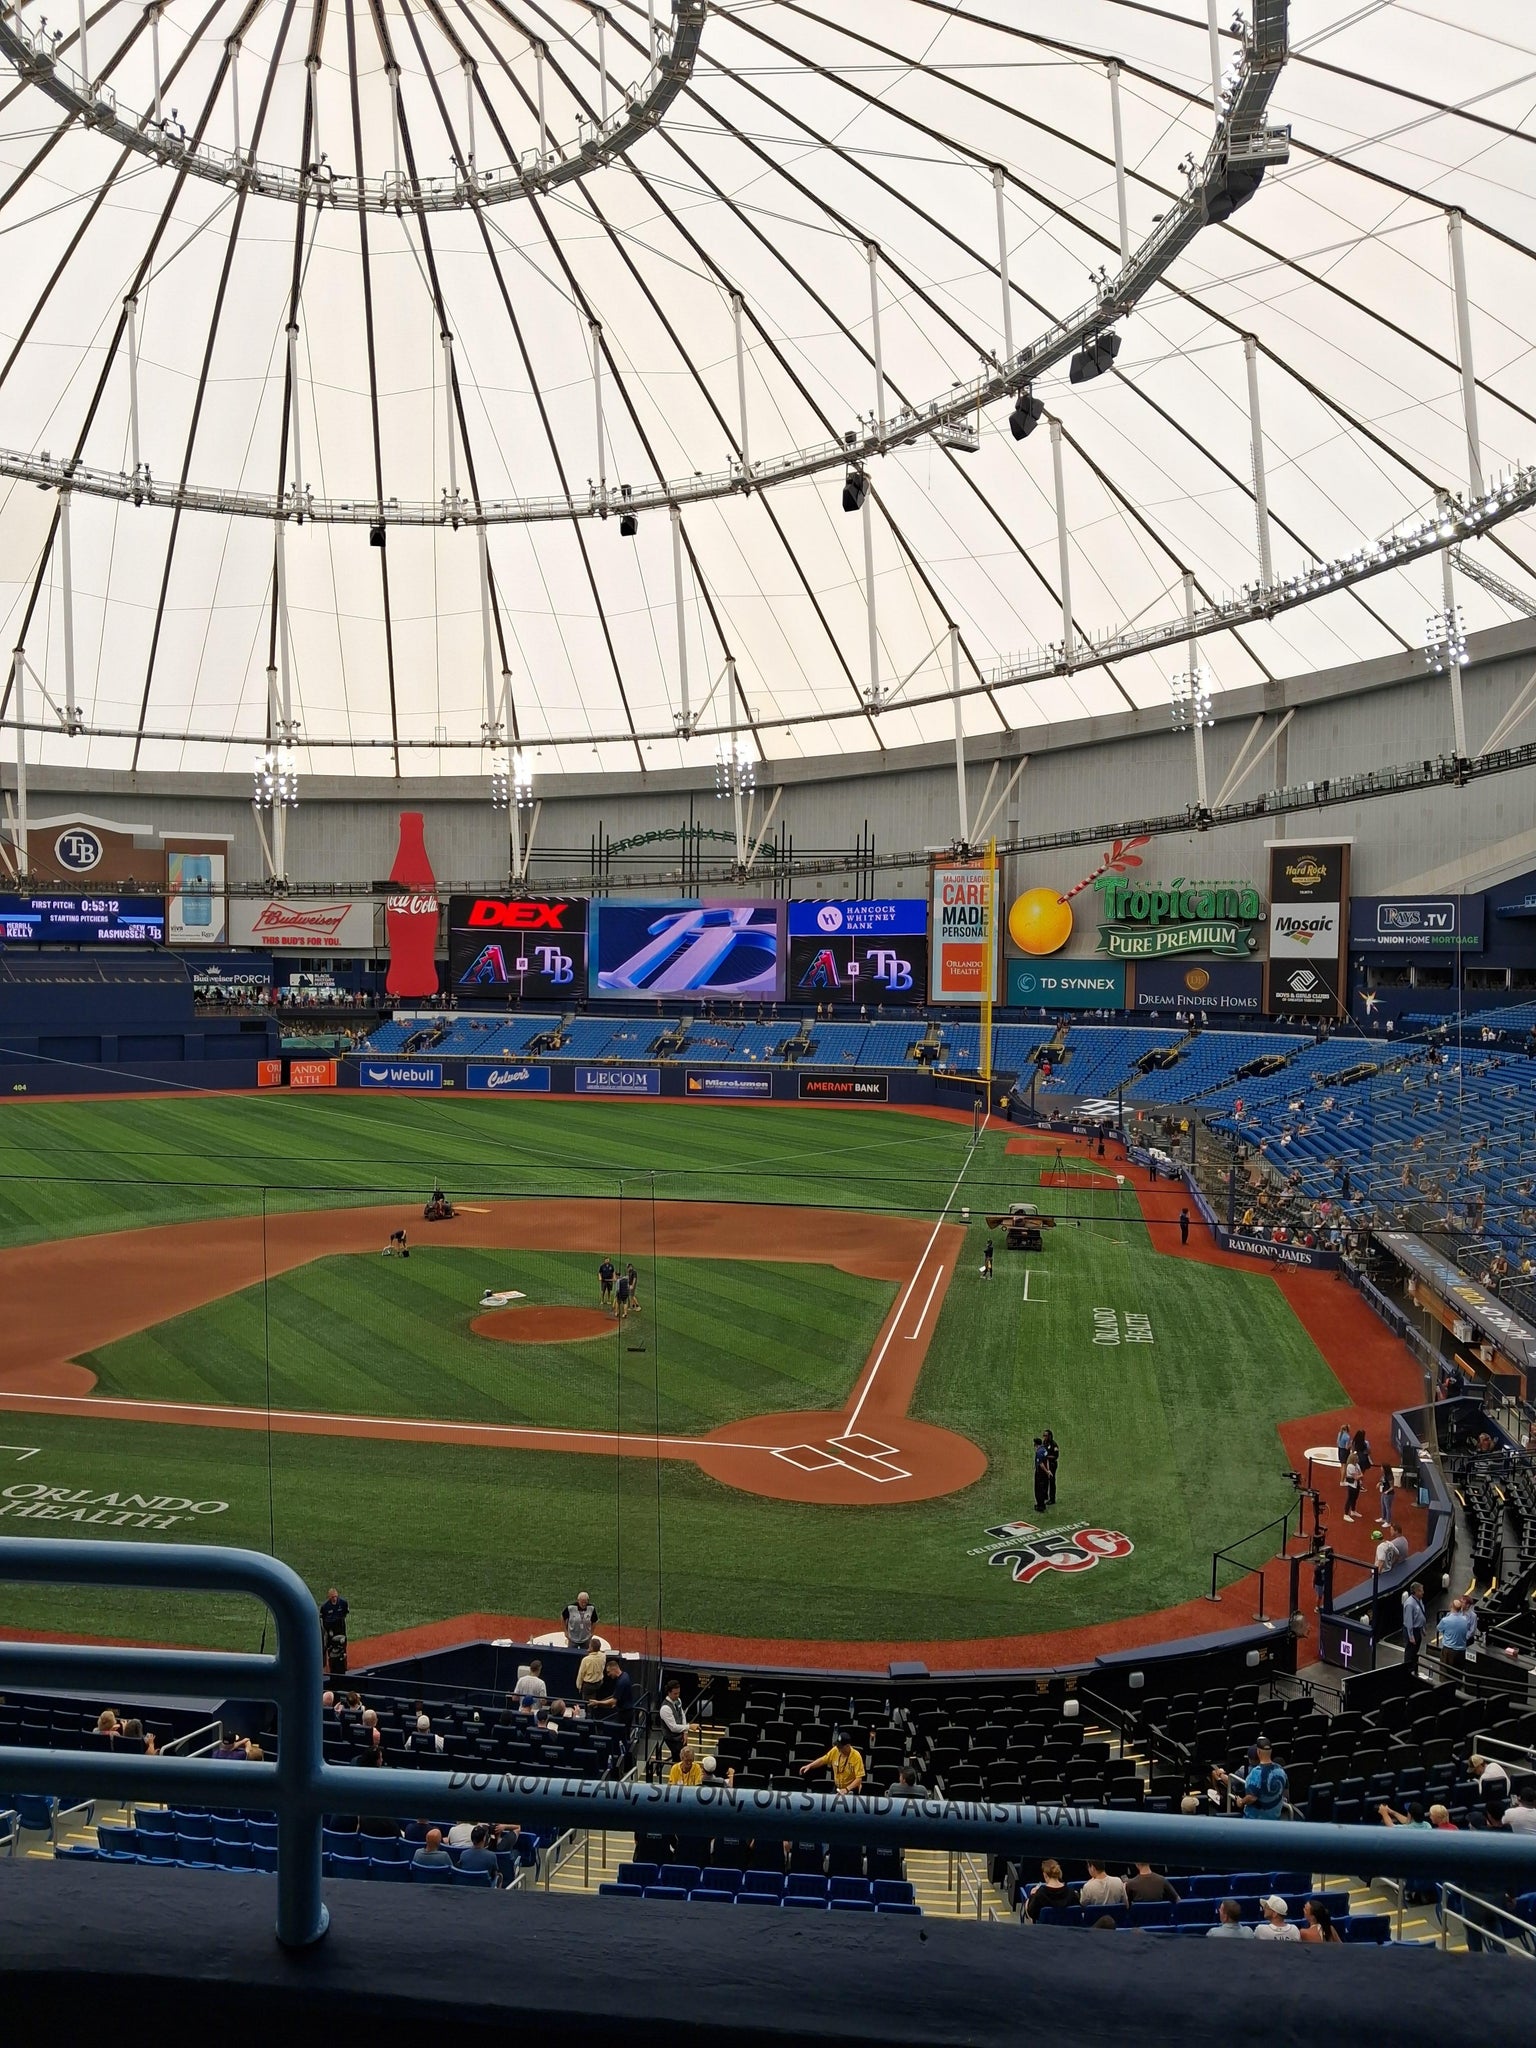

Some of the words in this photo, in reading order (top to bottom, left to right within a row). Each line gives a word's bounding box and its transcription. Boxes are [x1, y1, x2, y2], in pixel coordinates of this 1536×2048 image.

[1286, 865, 1306, 875] Hard
[1306, 864, 1327, 876] Rock
[942, 884, 990, 905] CARE
[1093, 875, 1260, 925] Tropicana
[32, 900, 52, 909] FIRST
[52, 901, 76, 910] PITCH:
[846, 906, 896, 914] HANCOCK
[260, 910, 343, 927] Budweiser
[468, 900, 568, 929] DEX
[846, 914, 896, 922] WHITNEY
[942, 906, 989, 925] MADE
[1275, 915, 1334, 932] Mosaic
[6, 928, 33, 938] KELLY
[98, 930, 146, 939] RASMUSSEN
[942, 926, 988, 938] PERSONAL
[262, 936, 280, 944] THIS
[281, 936, 306, 946] BUD'S
[307, 937, 322, 946] FOR
[324, 938, 342, 946] YOU.
[1110, 934, 1152, 952] PURE
[1156, 928, 1236, 950] PREMIUM
[193, 974, 234, 982] Budweiser
[234, 974, 270, 984] PORCH
[1040, 978, 1057, 988] TD
[1061, 978, 1115, 990] SYNNEX
[1138, 994, 1174, 1005] DREAM
[1177, 994, 1218, 1006] FINDERS
[1220, 996, 1258, 1007] HOMES
[390, 1068, 434, 1082] Webull
[488, 1068, 530, 1088] Culver's
[806, 1082, 854, 1092] AMERANT
[855, 1083, 880, 1093] BANK
[1278, 1249, 1312, 1264] JAMES
[1, 1484, 230, 1514] ORLANDO
[966, 1534, 1034, 1556] CELEBRATING
[1036, 1520, 1090, 1539] AMERICA'S
[448, 1772, 492, 1792] DO
[496, 1774, 552, 1794] NOT
[561, 1778, 641, 1806] LEAN,
[646, 1784, 684, 1804] SIT
[694, 1786, 746, 1812] ON,
[752, 1787, 793, 1810] OR
[798, 1792, 894, 1816] STAND
[900, 1798, 1024, 1824] AGAINST
[1035, 1804, 1101, 1829] RAIL
